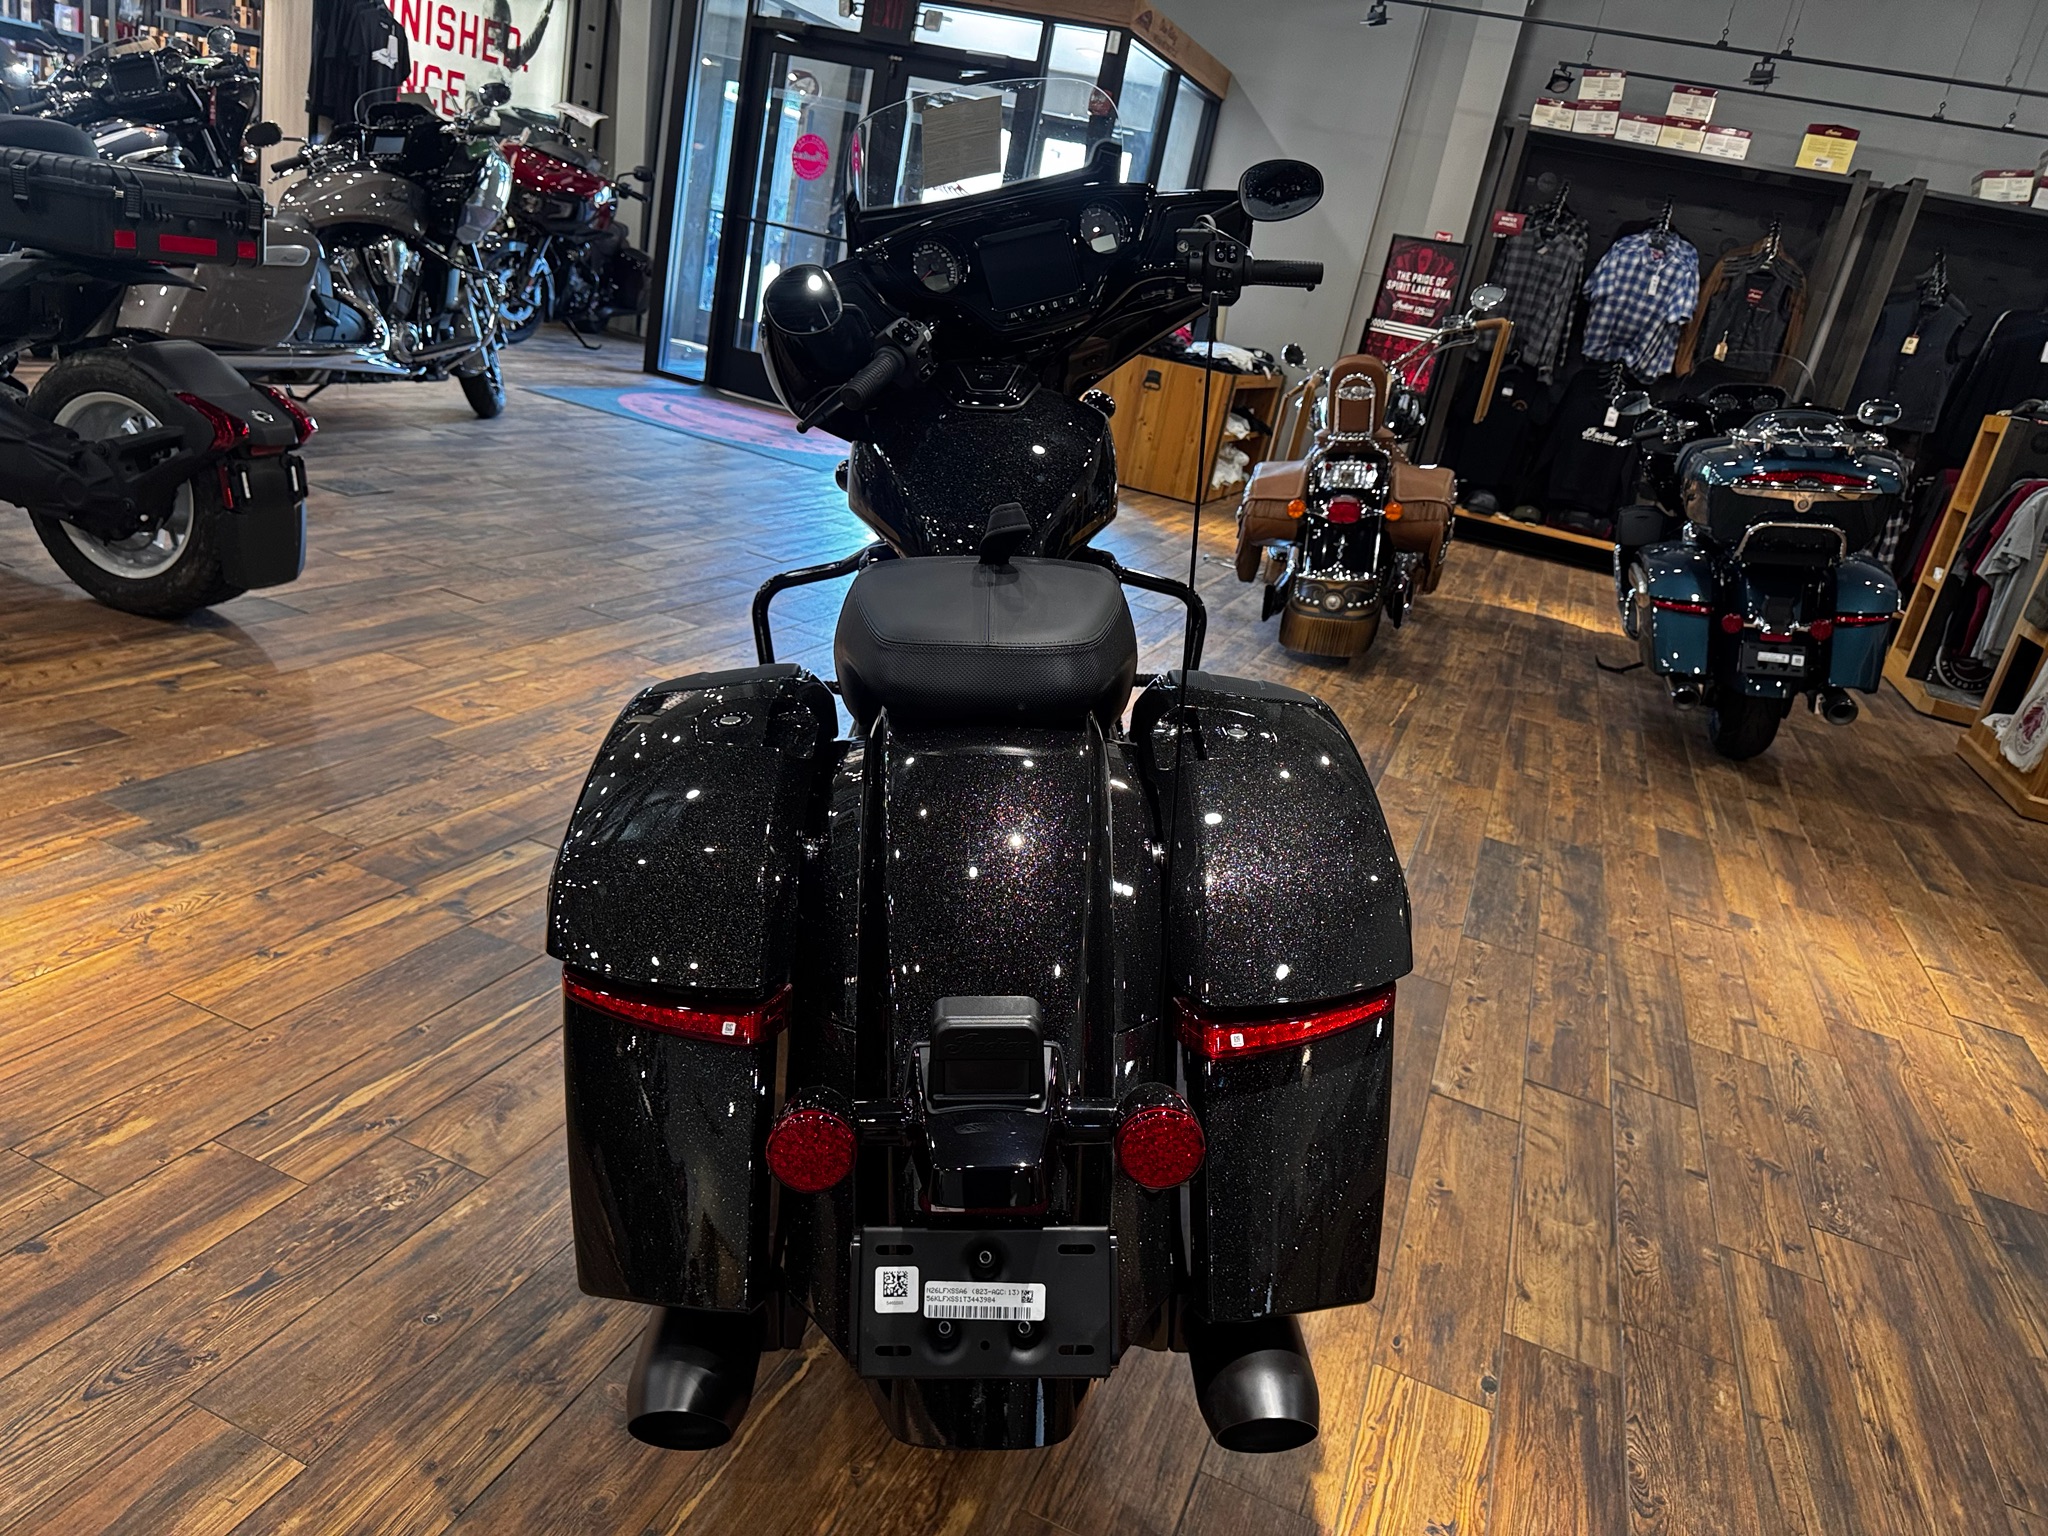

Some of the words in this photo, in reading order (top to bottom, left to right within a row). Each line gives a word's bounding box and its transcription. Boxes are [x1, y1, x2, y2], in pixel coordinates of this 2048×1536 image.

[1396, 270, 1412, 282] THE
[1411, 273, 1436, 286] PRIDE
[1435, 277, 1448, 288] OF
[1386, 279, 1411, 293] SPIRIT
[1411, 284, 1433, 297] LAKE
[1432, 288, 1452, 300] IOWA
